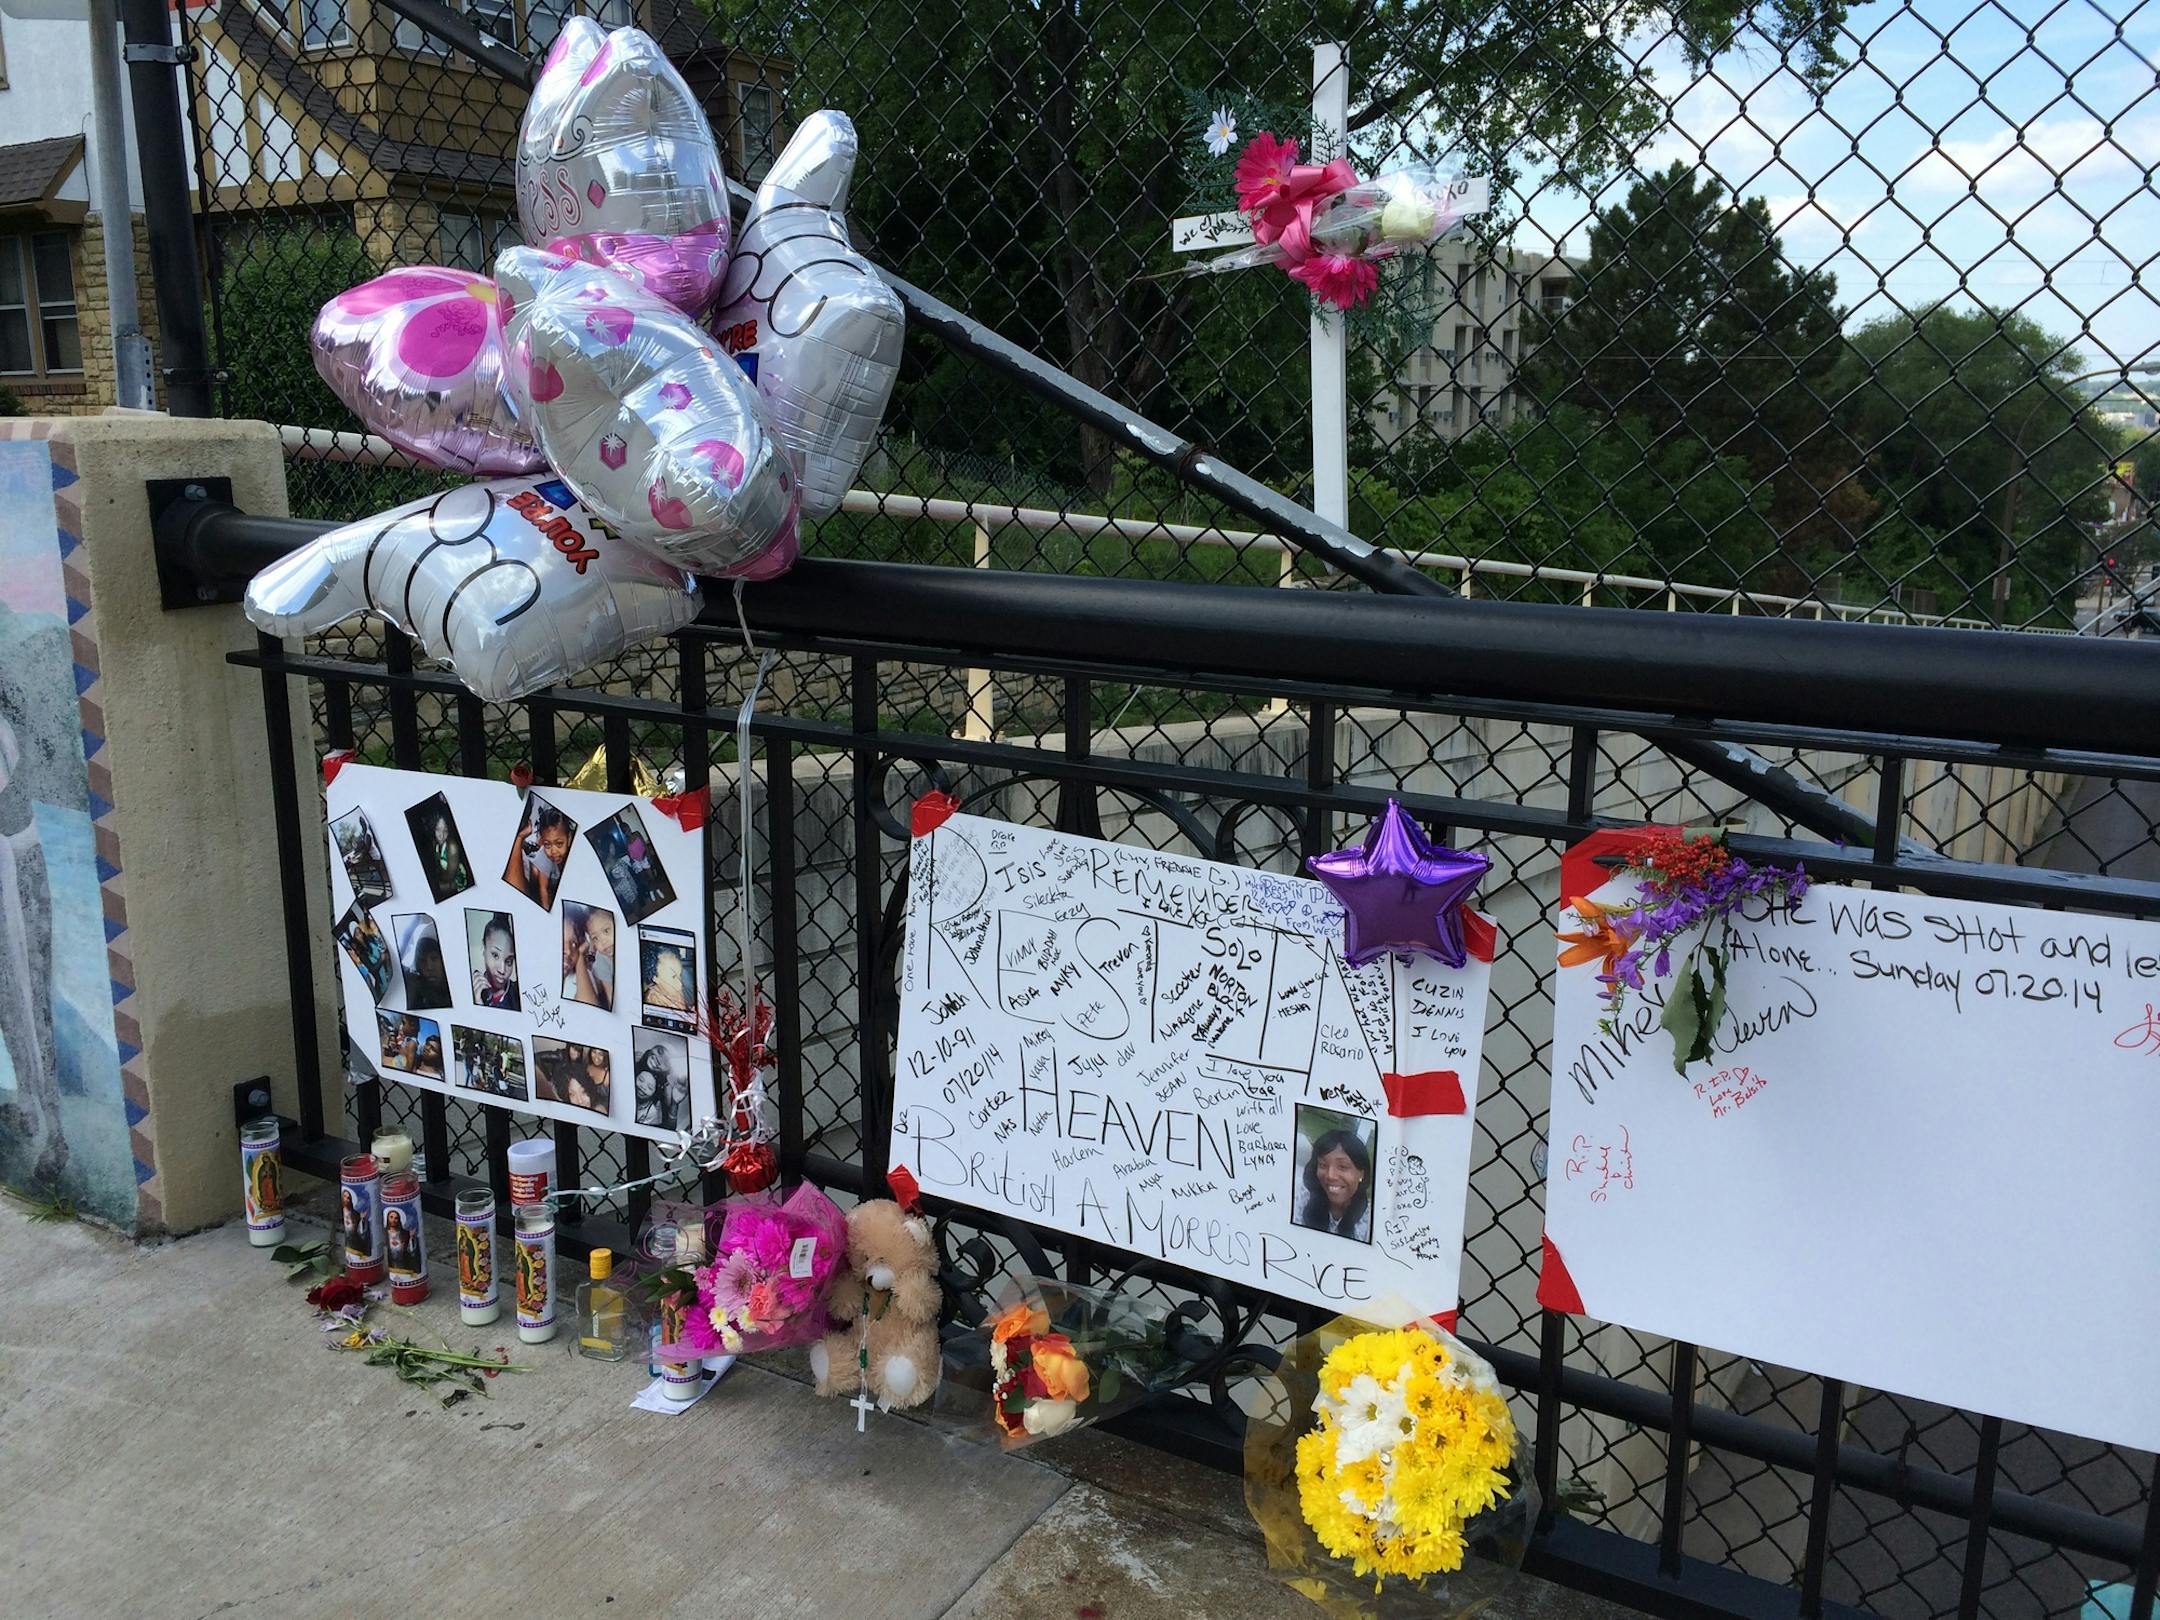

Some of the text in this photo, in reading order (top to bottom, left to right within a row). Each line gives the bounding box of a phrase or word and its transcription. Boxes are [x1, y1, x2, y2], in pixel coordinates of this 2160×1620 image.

[1850, 950, 1961, 1014] Sunday
[1975, 968, 2103, 1014] 07.20.14
[2040, 933, 2112, 969] and
[2125, 938, 2160, 980] le
[907, 1026, 976, 1079] 12-10-91
[942, 1043, 1004, 1104] 07/20/14
[1019, 1042, 1235, 1179] HEAVEN
